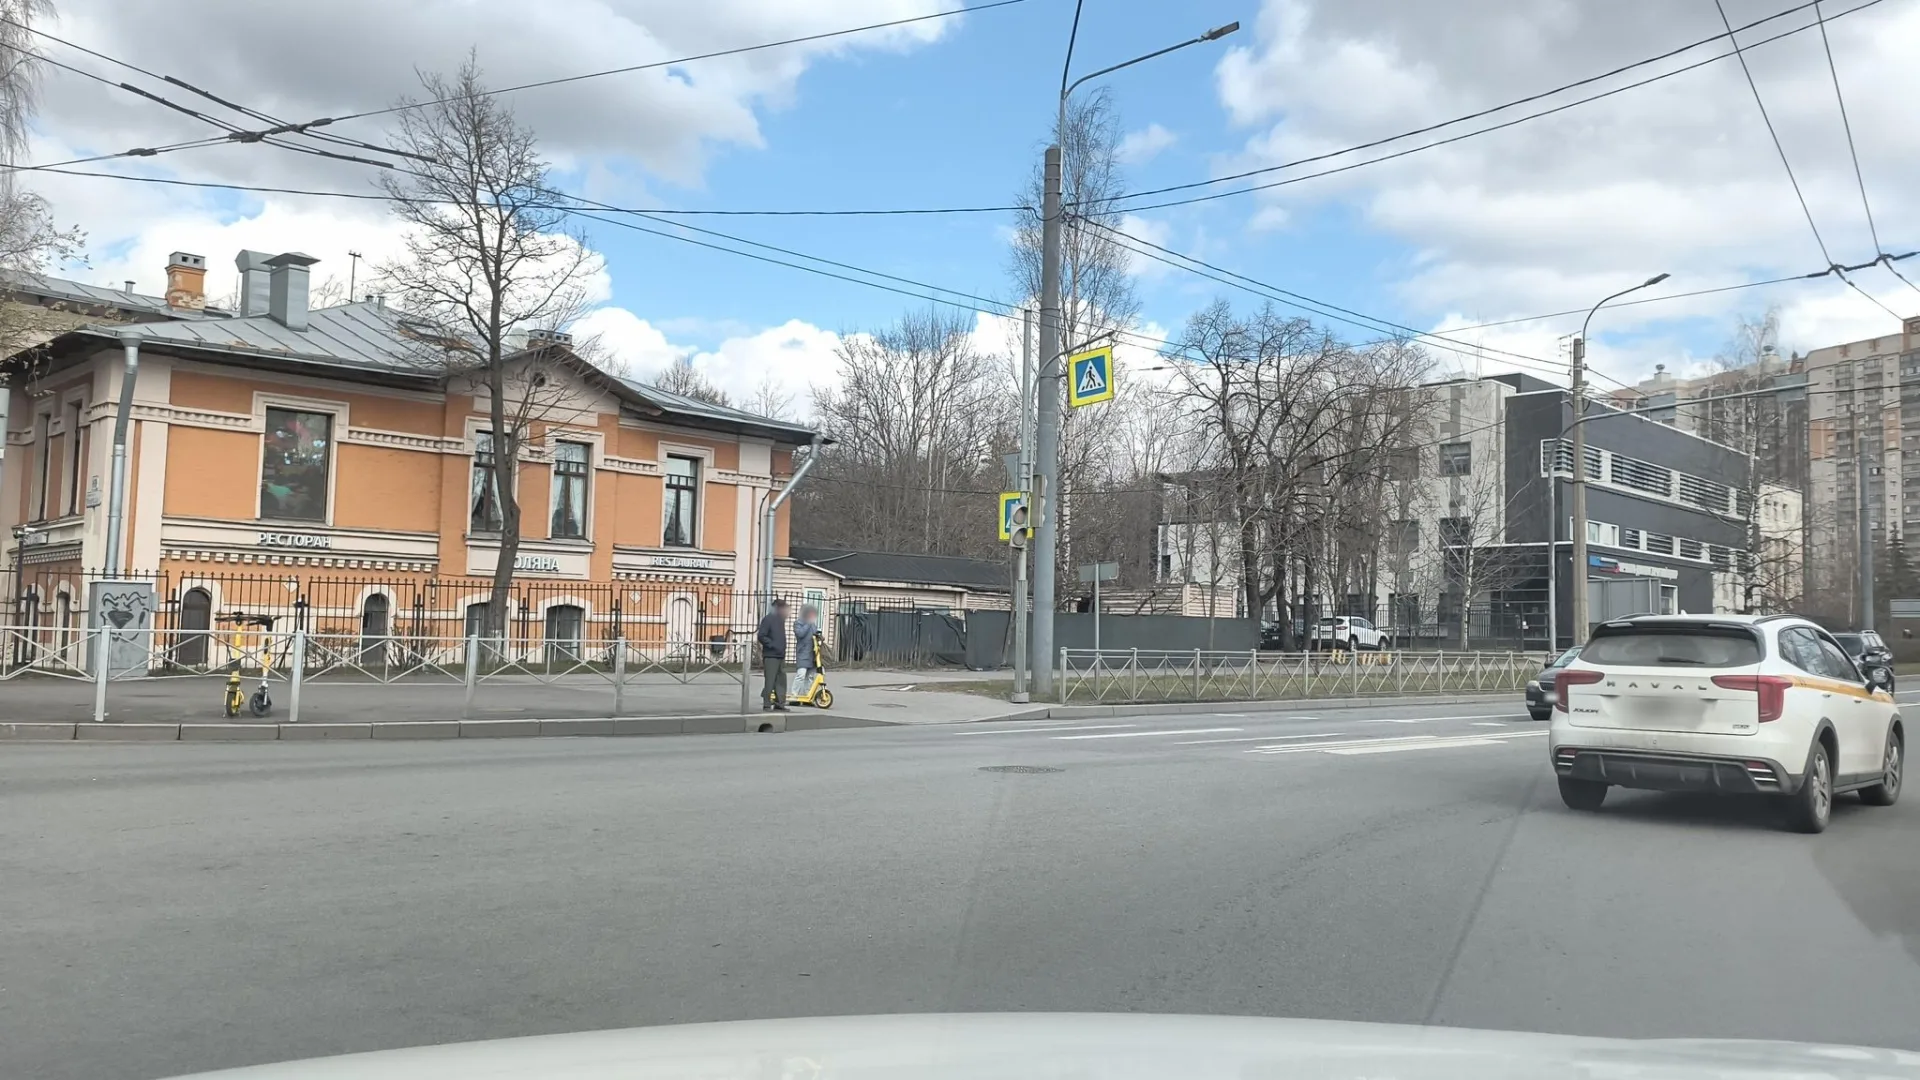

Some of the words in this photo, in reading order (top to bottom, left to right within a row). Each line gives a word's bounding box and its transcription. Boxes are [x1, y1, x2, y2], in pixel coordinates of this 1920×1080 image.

[258, 532, 332, 548] РЕСТОРАН
[513, 556, 560, 571] ОЛЯНА
[652, 556, 713, 568] RESTAURANT
[1606, 681, 1707, 691] HAVAL
